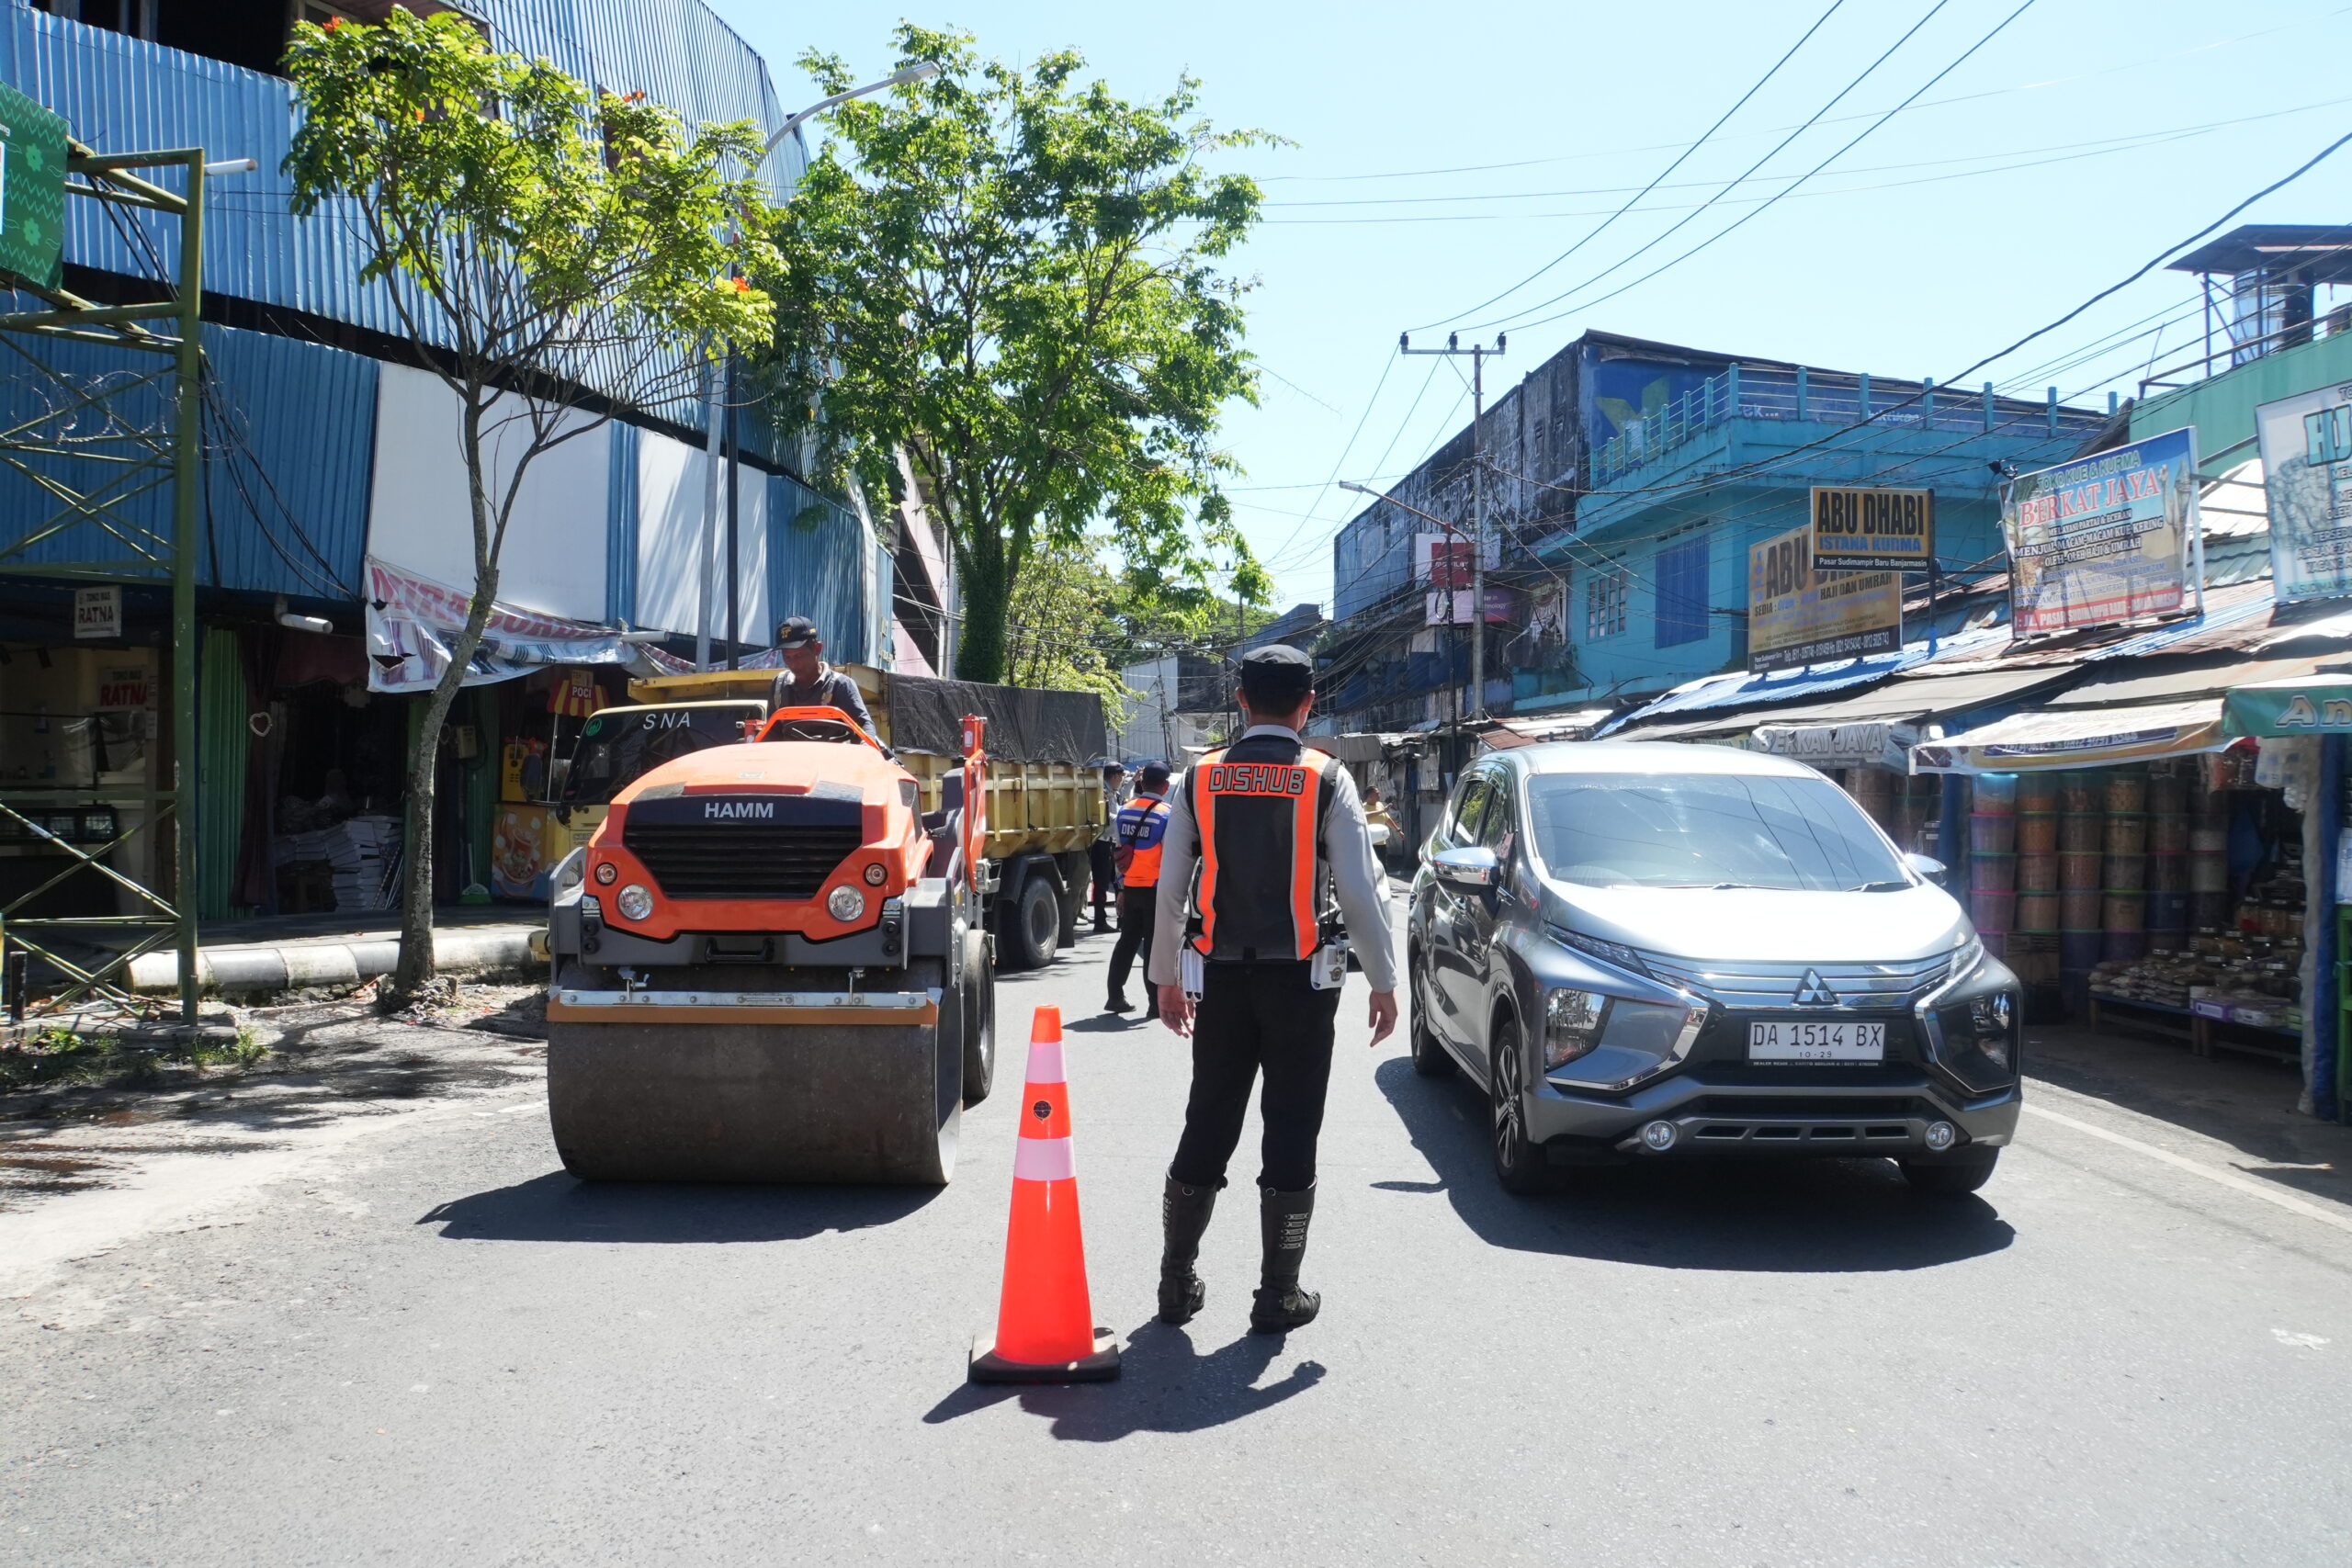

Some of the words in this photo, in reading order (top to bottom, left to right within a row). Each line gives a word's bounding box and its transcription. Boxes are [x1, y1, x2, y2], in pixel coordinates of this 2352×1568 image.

[2065, 464, 2088, 486] KUE
[2089, 462, 2098, 478] &
[2099, 450, 2142, 476] KURMA
[2019, 482, 2101, 526] BERKAT
[2105, 468, 2161, 508] JAYA
[1817, 491, 1858, 534] ABU
[1863, 493, 1924, 536] DHABI
[1819, 536, 1869, 550] ISTANA
[1872, 536, 1921, 552] KURMA
[2016, 540, 2056, 558] MENJUAL
[2133, 515, 2164, 535] KERING
[1766, 535, 1808, 600] ABU
[1819, 558, 1837, 566] Pasar
[1838, 558, 1873, 568] Sudimampir
[1875, 558, 1889, 567] Baru
[1890, 559, 1928, 570] Banjarmasin
[1755, 602, 1773, 617] SEDIA
[1820, 586, 1838, 601] HAJI
[1838, 581, 1857, 597] DAN
[1859, 572, 1893, 592] UMRAH
[78, 605, 114, 624] RATNA
[571, 686, 592, 698] POCI
[643, 711, 691, 730] SNA
[1833, 724, 1883, 753] JAYA
[1208, 766, 1306, 795] DISHUB
[705, 802, 774, 818] HAMM
[1121, 823, 1149, 838] DISUB
[1753, 1024, 1778, 1046] DA
[1790, 1024, 1843, 1046] 1514
[1856, 1025, 1883, 1047] BX
